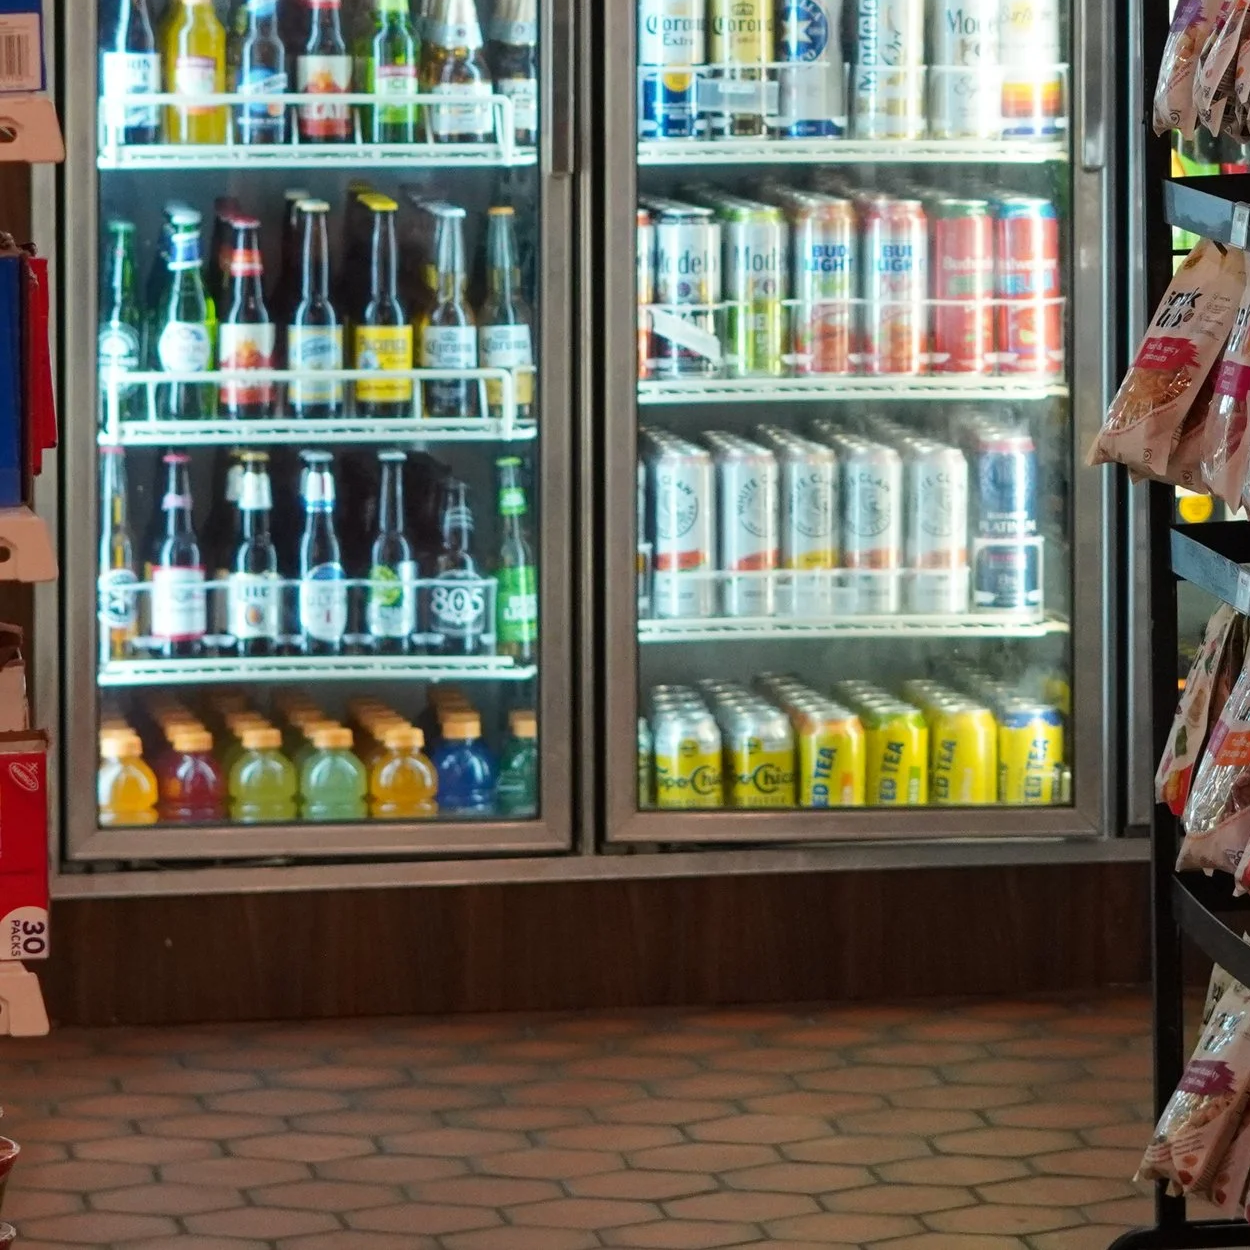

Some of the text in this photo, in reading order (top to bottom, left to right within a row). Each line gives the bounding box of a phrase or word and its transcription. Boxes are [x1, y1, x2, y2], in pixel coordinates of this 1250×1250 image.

[430, 585, 485, 619] 805
[816, 746, 838, 781] TEA
[882, 741, 904, 775] TEA
[10, 919, 22, 957] PACKS
[22, 920, 46, 955] 30
